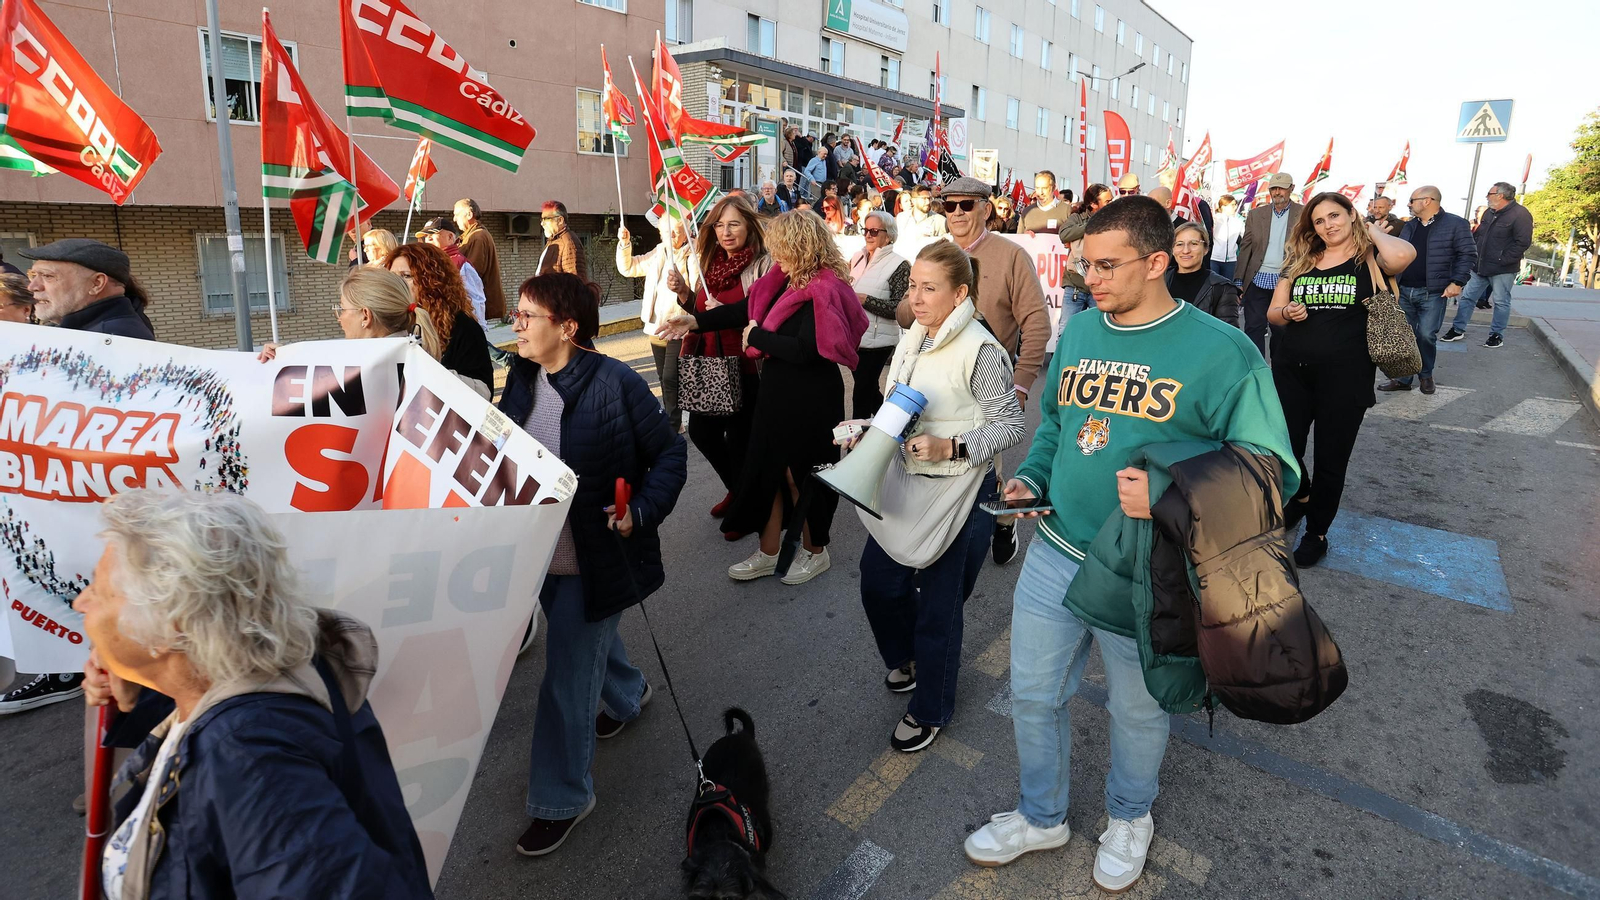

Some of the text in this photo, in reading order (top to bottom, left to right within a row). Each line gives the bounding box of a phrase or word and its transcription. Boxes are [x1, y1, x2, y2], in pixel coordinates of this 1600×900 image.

[851, 21, 869, 33] Hospital
[853, 11, 870, 22] Hospital
[869, 15, 892, 31] Universitario
[11, 21, 116, 163] CCOO
[459, 81, 525, 126] Cádiz
[1293, 283, 1357, 296] NO SE VENDE
[1293, 293, 1356, 304] SE DEFIENDE
[1295, 274, 1357, 286] ANDALUCÍA
[271, 364, 368, 418] EN
[1076, 358, 1151, 384] HAWKINS
[1057, 365, 1184, 423] TIGERS
[0, 397, 176, 459] MAREA
[0, 450, 177, 498] BLANCA
[10, 599, 84, 645] PUERTO
